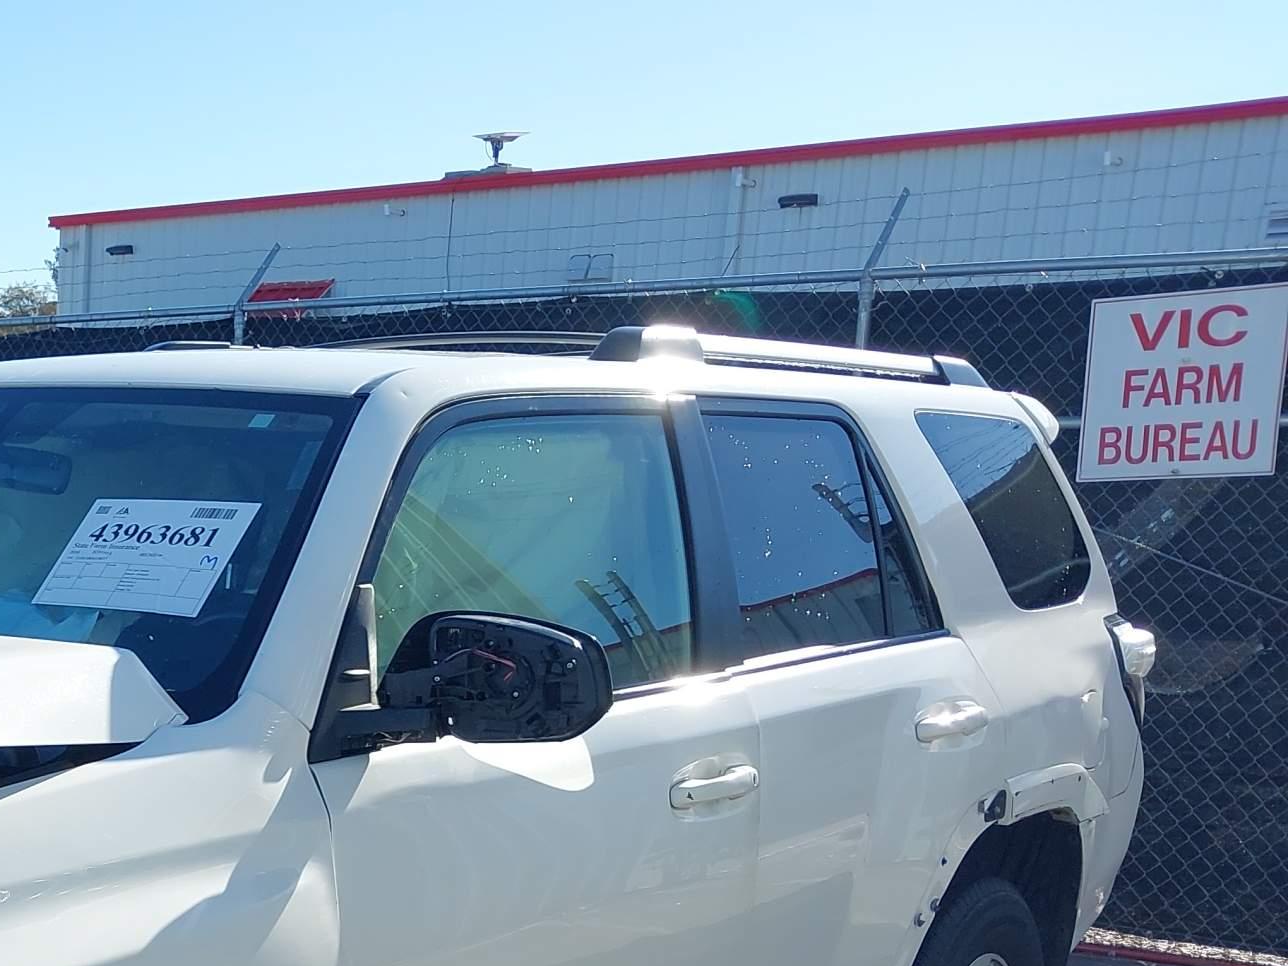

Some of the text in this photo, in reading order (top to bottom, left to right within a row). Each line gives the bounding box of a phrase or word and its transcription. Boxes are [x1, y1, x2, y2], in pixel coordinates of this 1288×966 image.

[1129, 304, 1249, 351] VIC
[1122, 362, 1244, 408] FARM
[1097, 419, 1258, 465] BUREAU
[89, 523, 220, 548] 43963681
